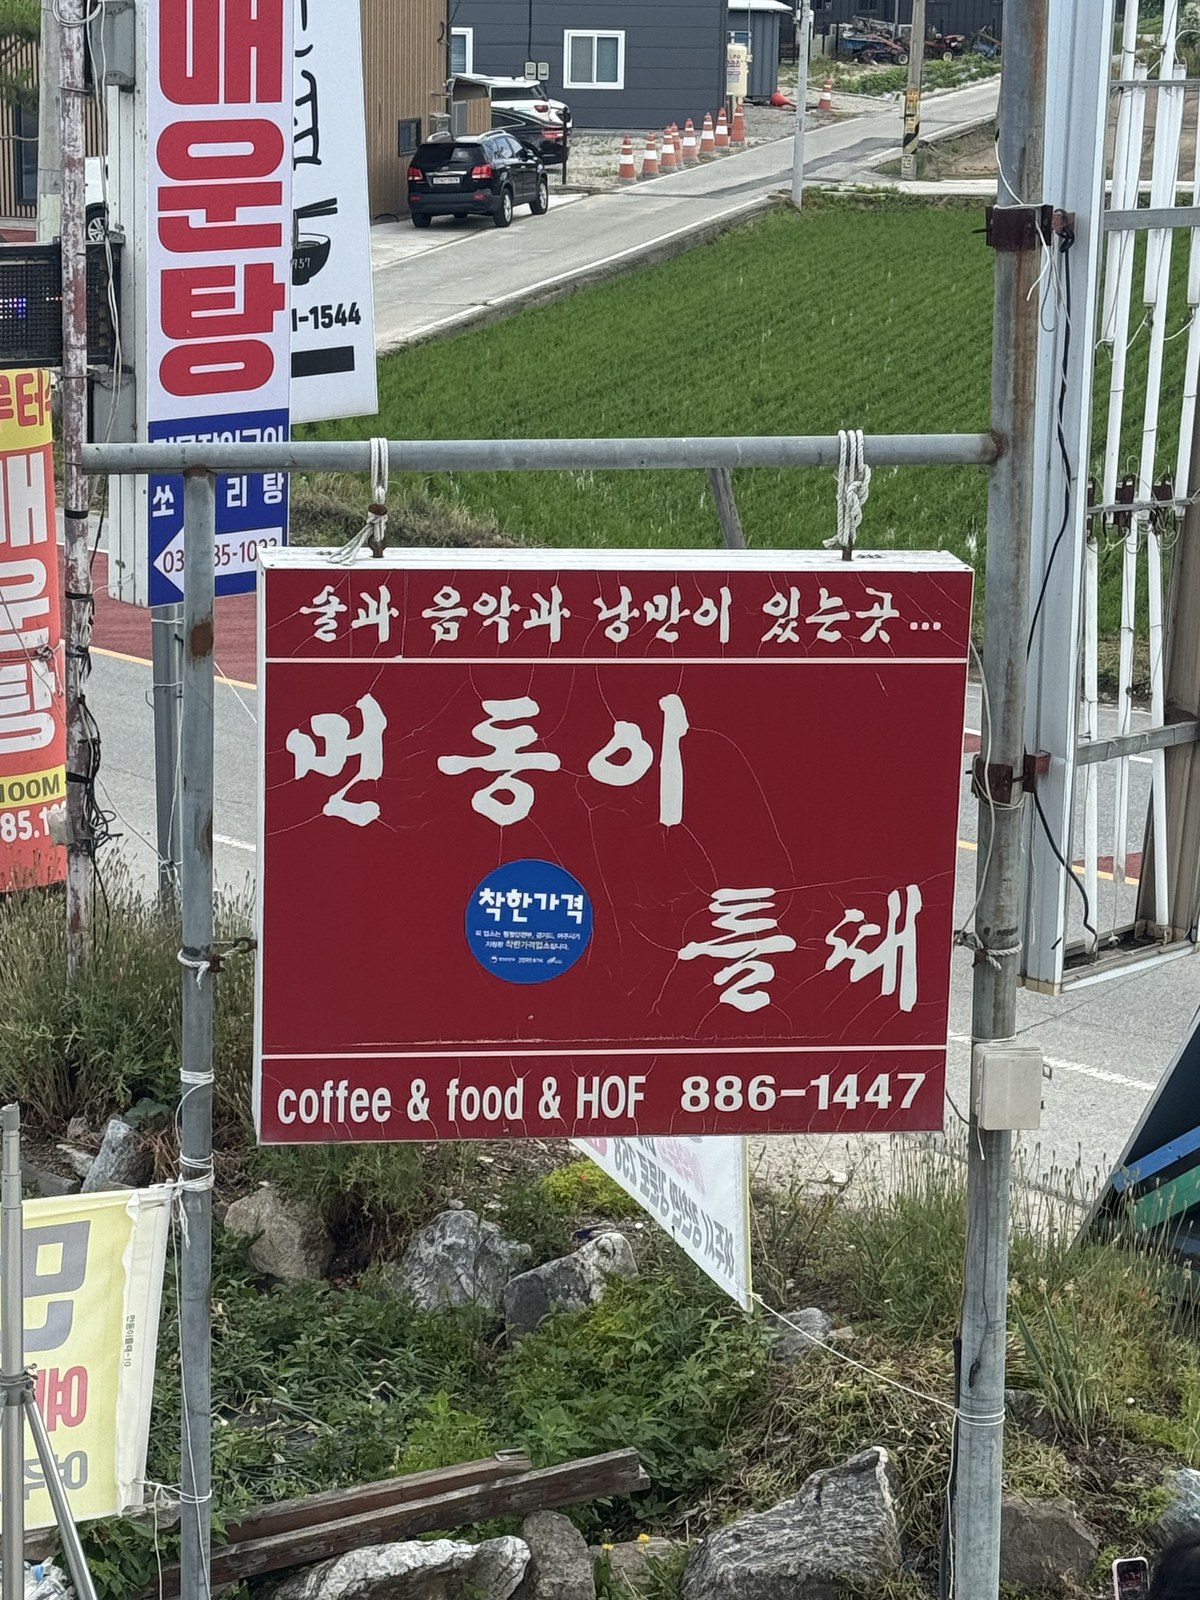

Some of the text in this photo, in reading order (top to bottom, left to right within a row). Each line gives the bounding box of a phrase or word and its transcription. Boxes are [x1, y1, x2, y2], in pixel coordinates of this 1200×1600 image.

[300, 583, 399, 644] 술과
[421, 584, 571, 645] 음악과
[593, 584, 733, 645] 낭만이
[478, 887, 584, 925] 착한가격
[277, 1071, 927, 1126] coffee & food & HOF 886-1447
